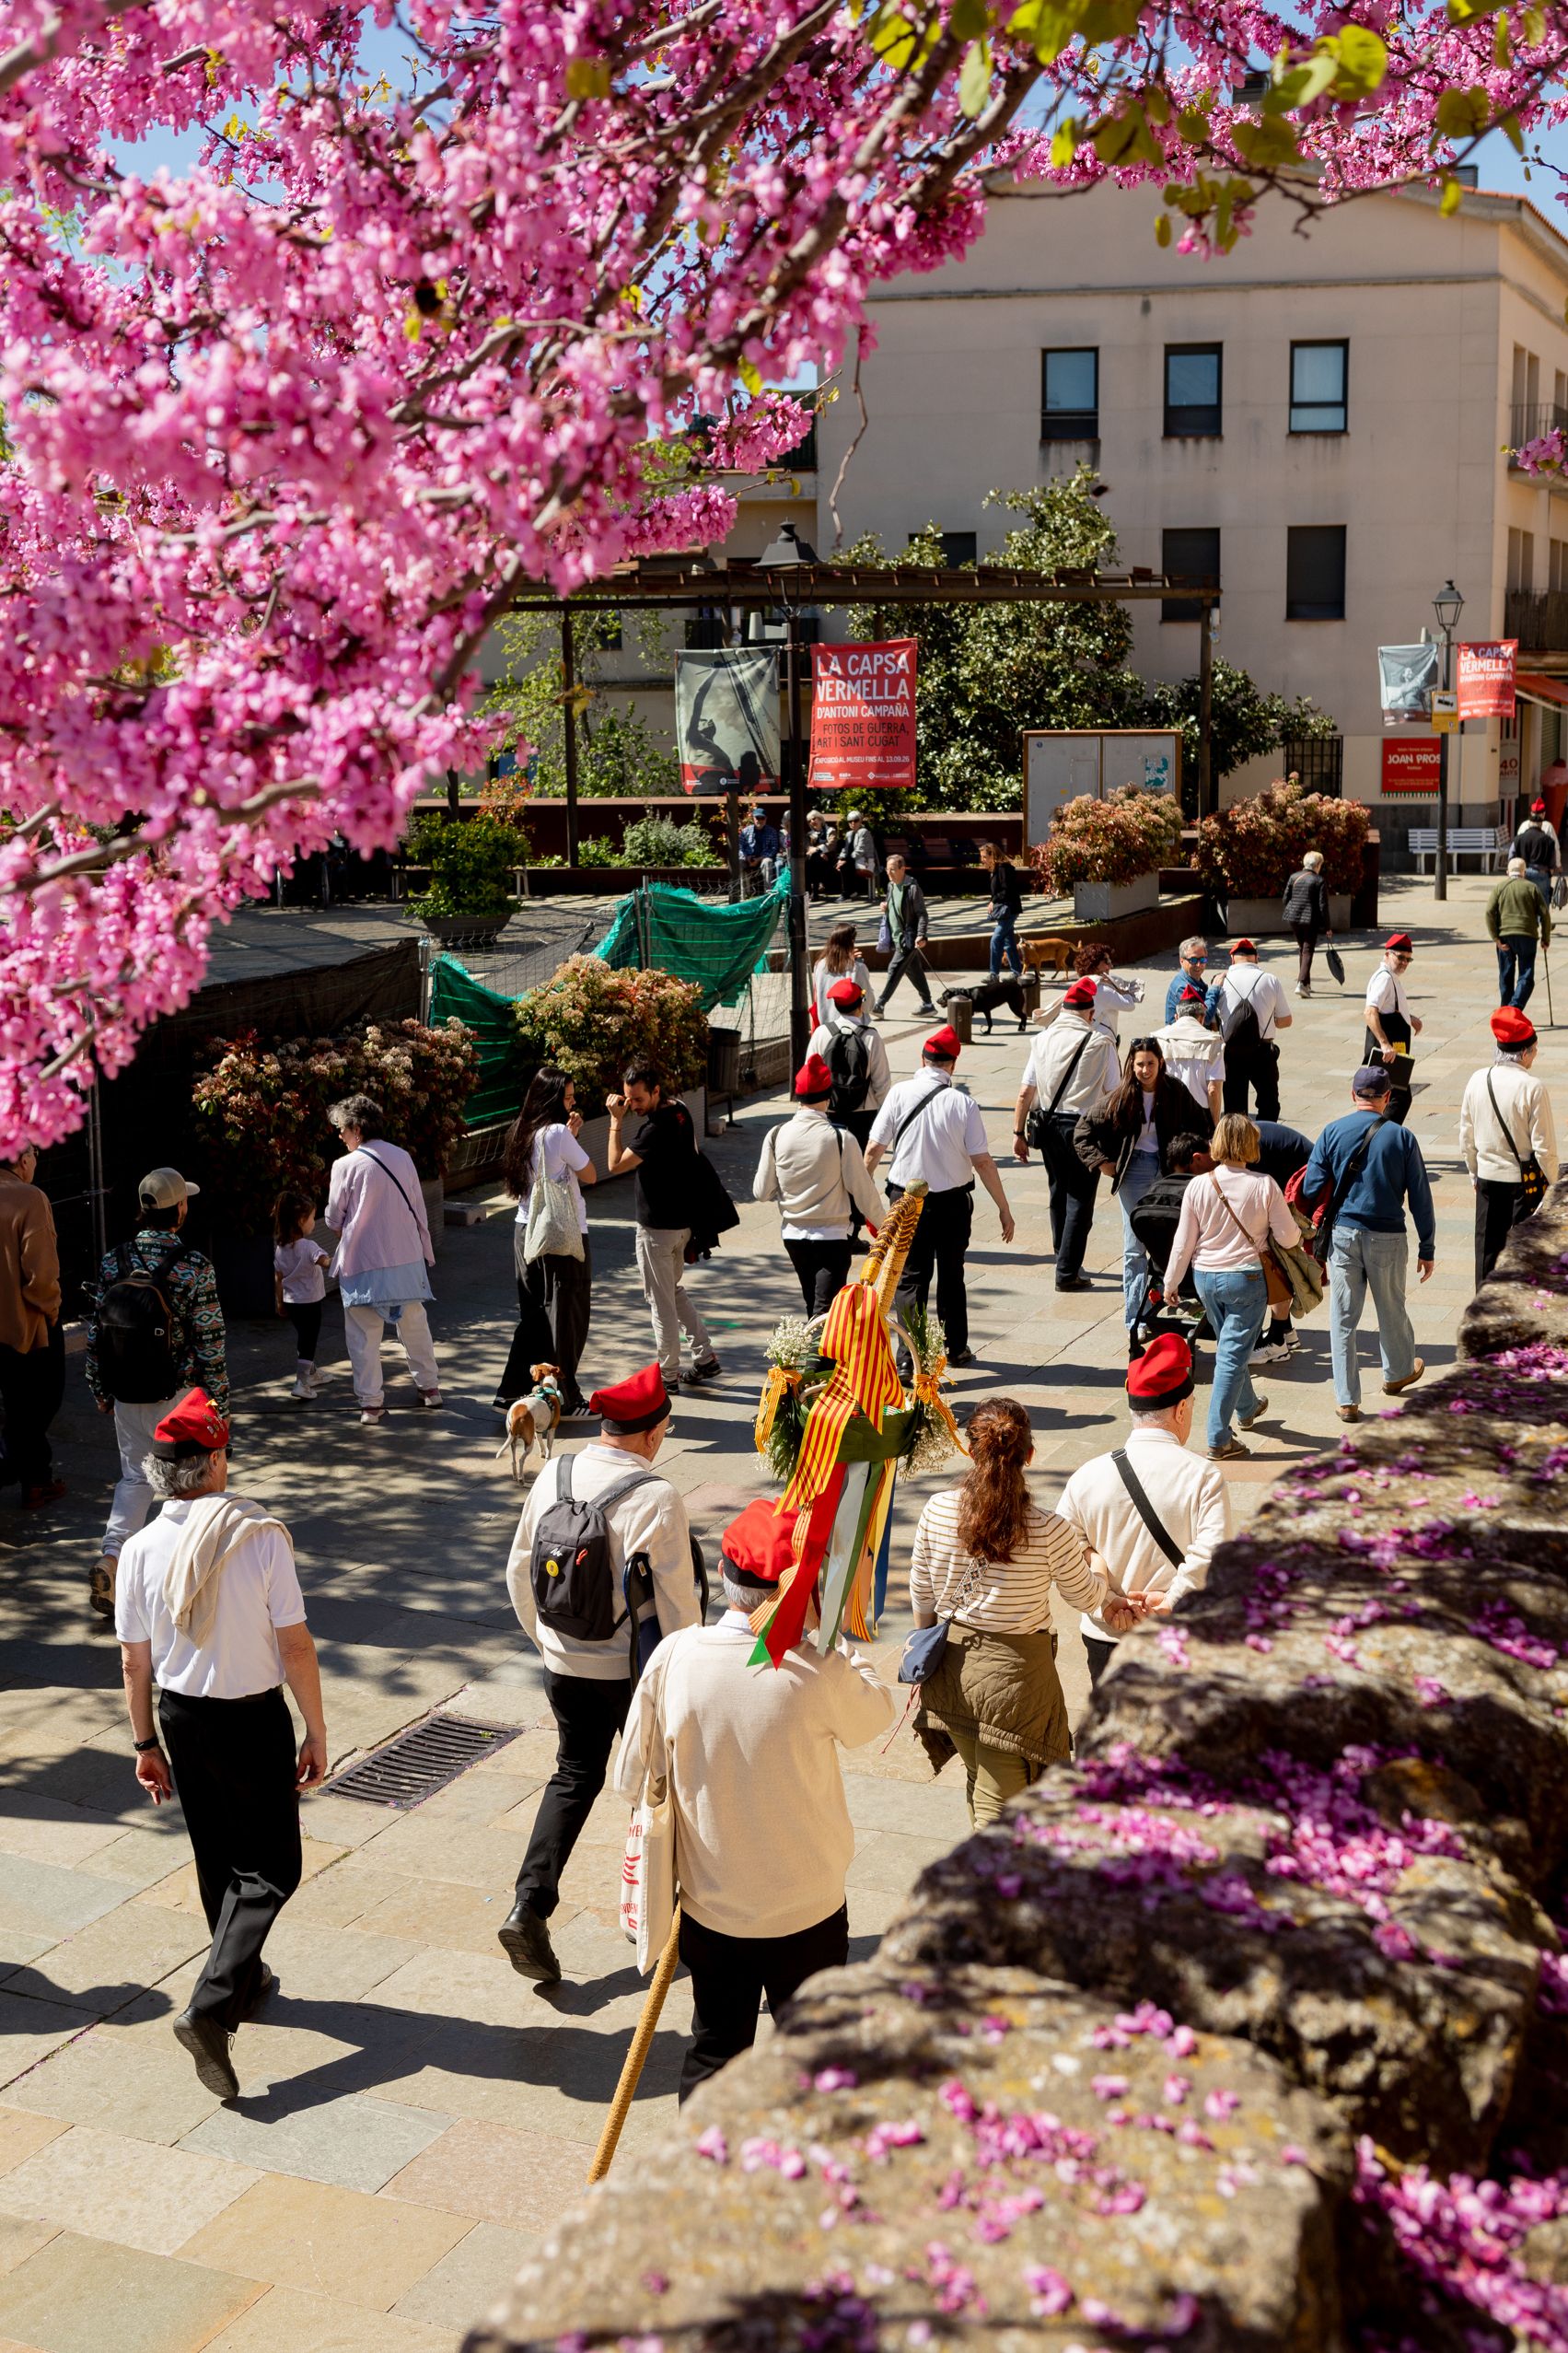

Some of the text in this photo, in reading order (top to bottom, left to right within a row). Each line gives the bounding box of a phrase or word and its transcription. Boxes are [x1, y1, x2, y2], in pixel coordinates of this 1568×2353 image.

[1478, 646, 1514, 658] CAPSA
[817, 652, 911, 677] LA CAPSA
[1460, 658, 1513, 674] VERMELLA
[817, 678, 911, 702] VERMELLA
[817, 702, 910, 718] D'ANTONI CAMPAÑÀ
[823, 722, 910, 736] FOTOS DE GUERRA,
[817, 737, 832, 748] ART
[840, 736, 865, 747] SANT
[867, 735, 900, 747] CUGAT
[846, 755, 865, 763] MUSEU
[1388, 753, 1441, 764] JOAN PROS
[1500, 758, 1517, 770] 40
